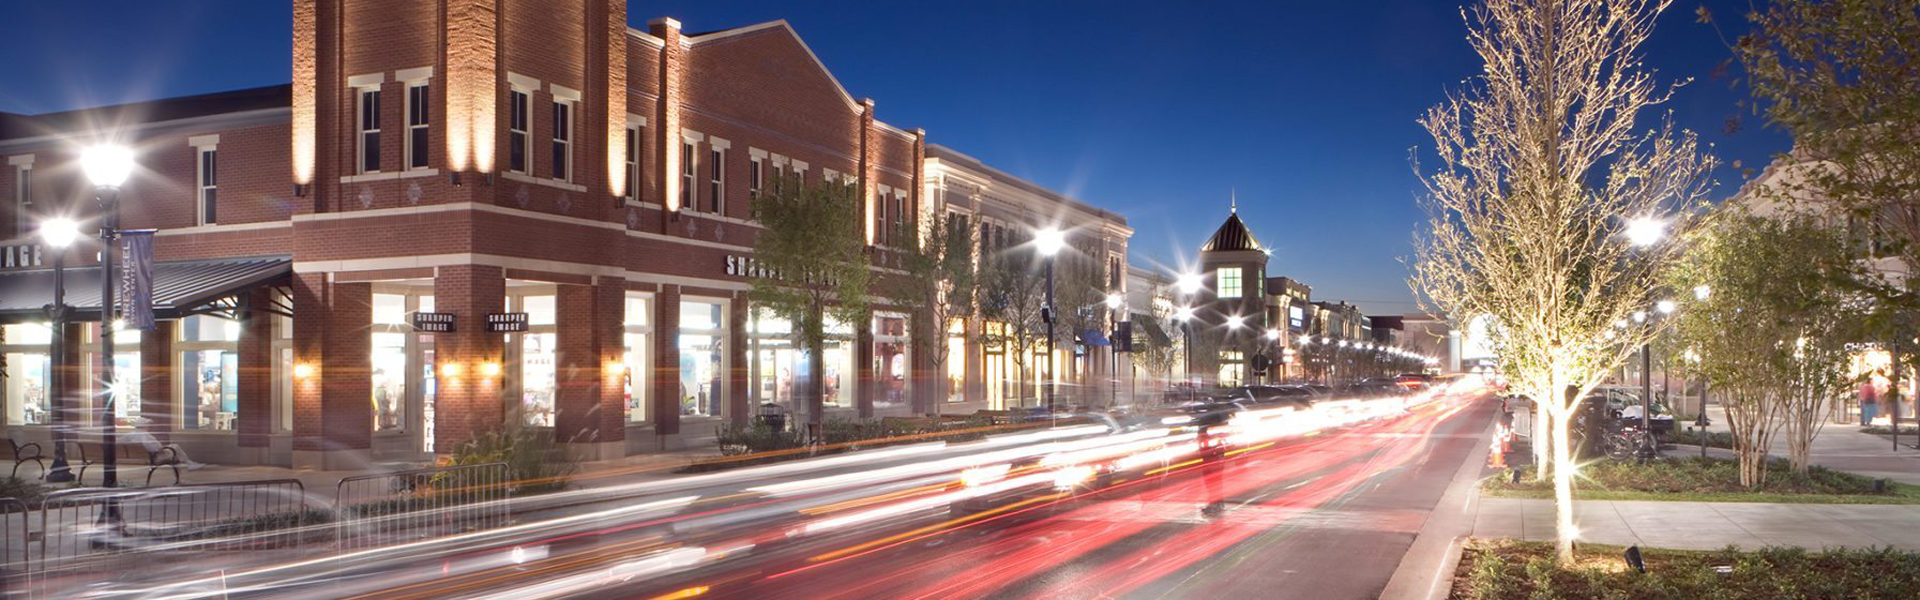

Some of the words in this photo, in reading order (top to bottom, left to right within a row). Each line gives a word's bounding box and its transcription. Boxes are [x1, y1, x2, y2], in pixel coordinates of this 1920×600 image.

[0, 244, 42, 268] AGE
[417, 313, 453, 322] SHARPER
[489, 313, 526, 322] SHARPER
[422, 323, 448, 331] IMAGE
[494, 323, 520, 331] IMAGE
